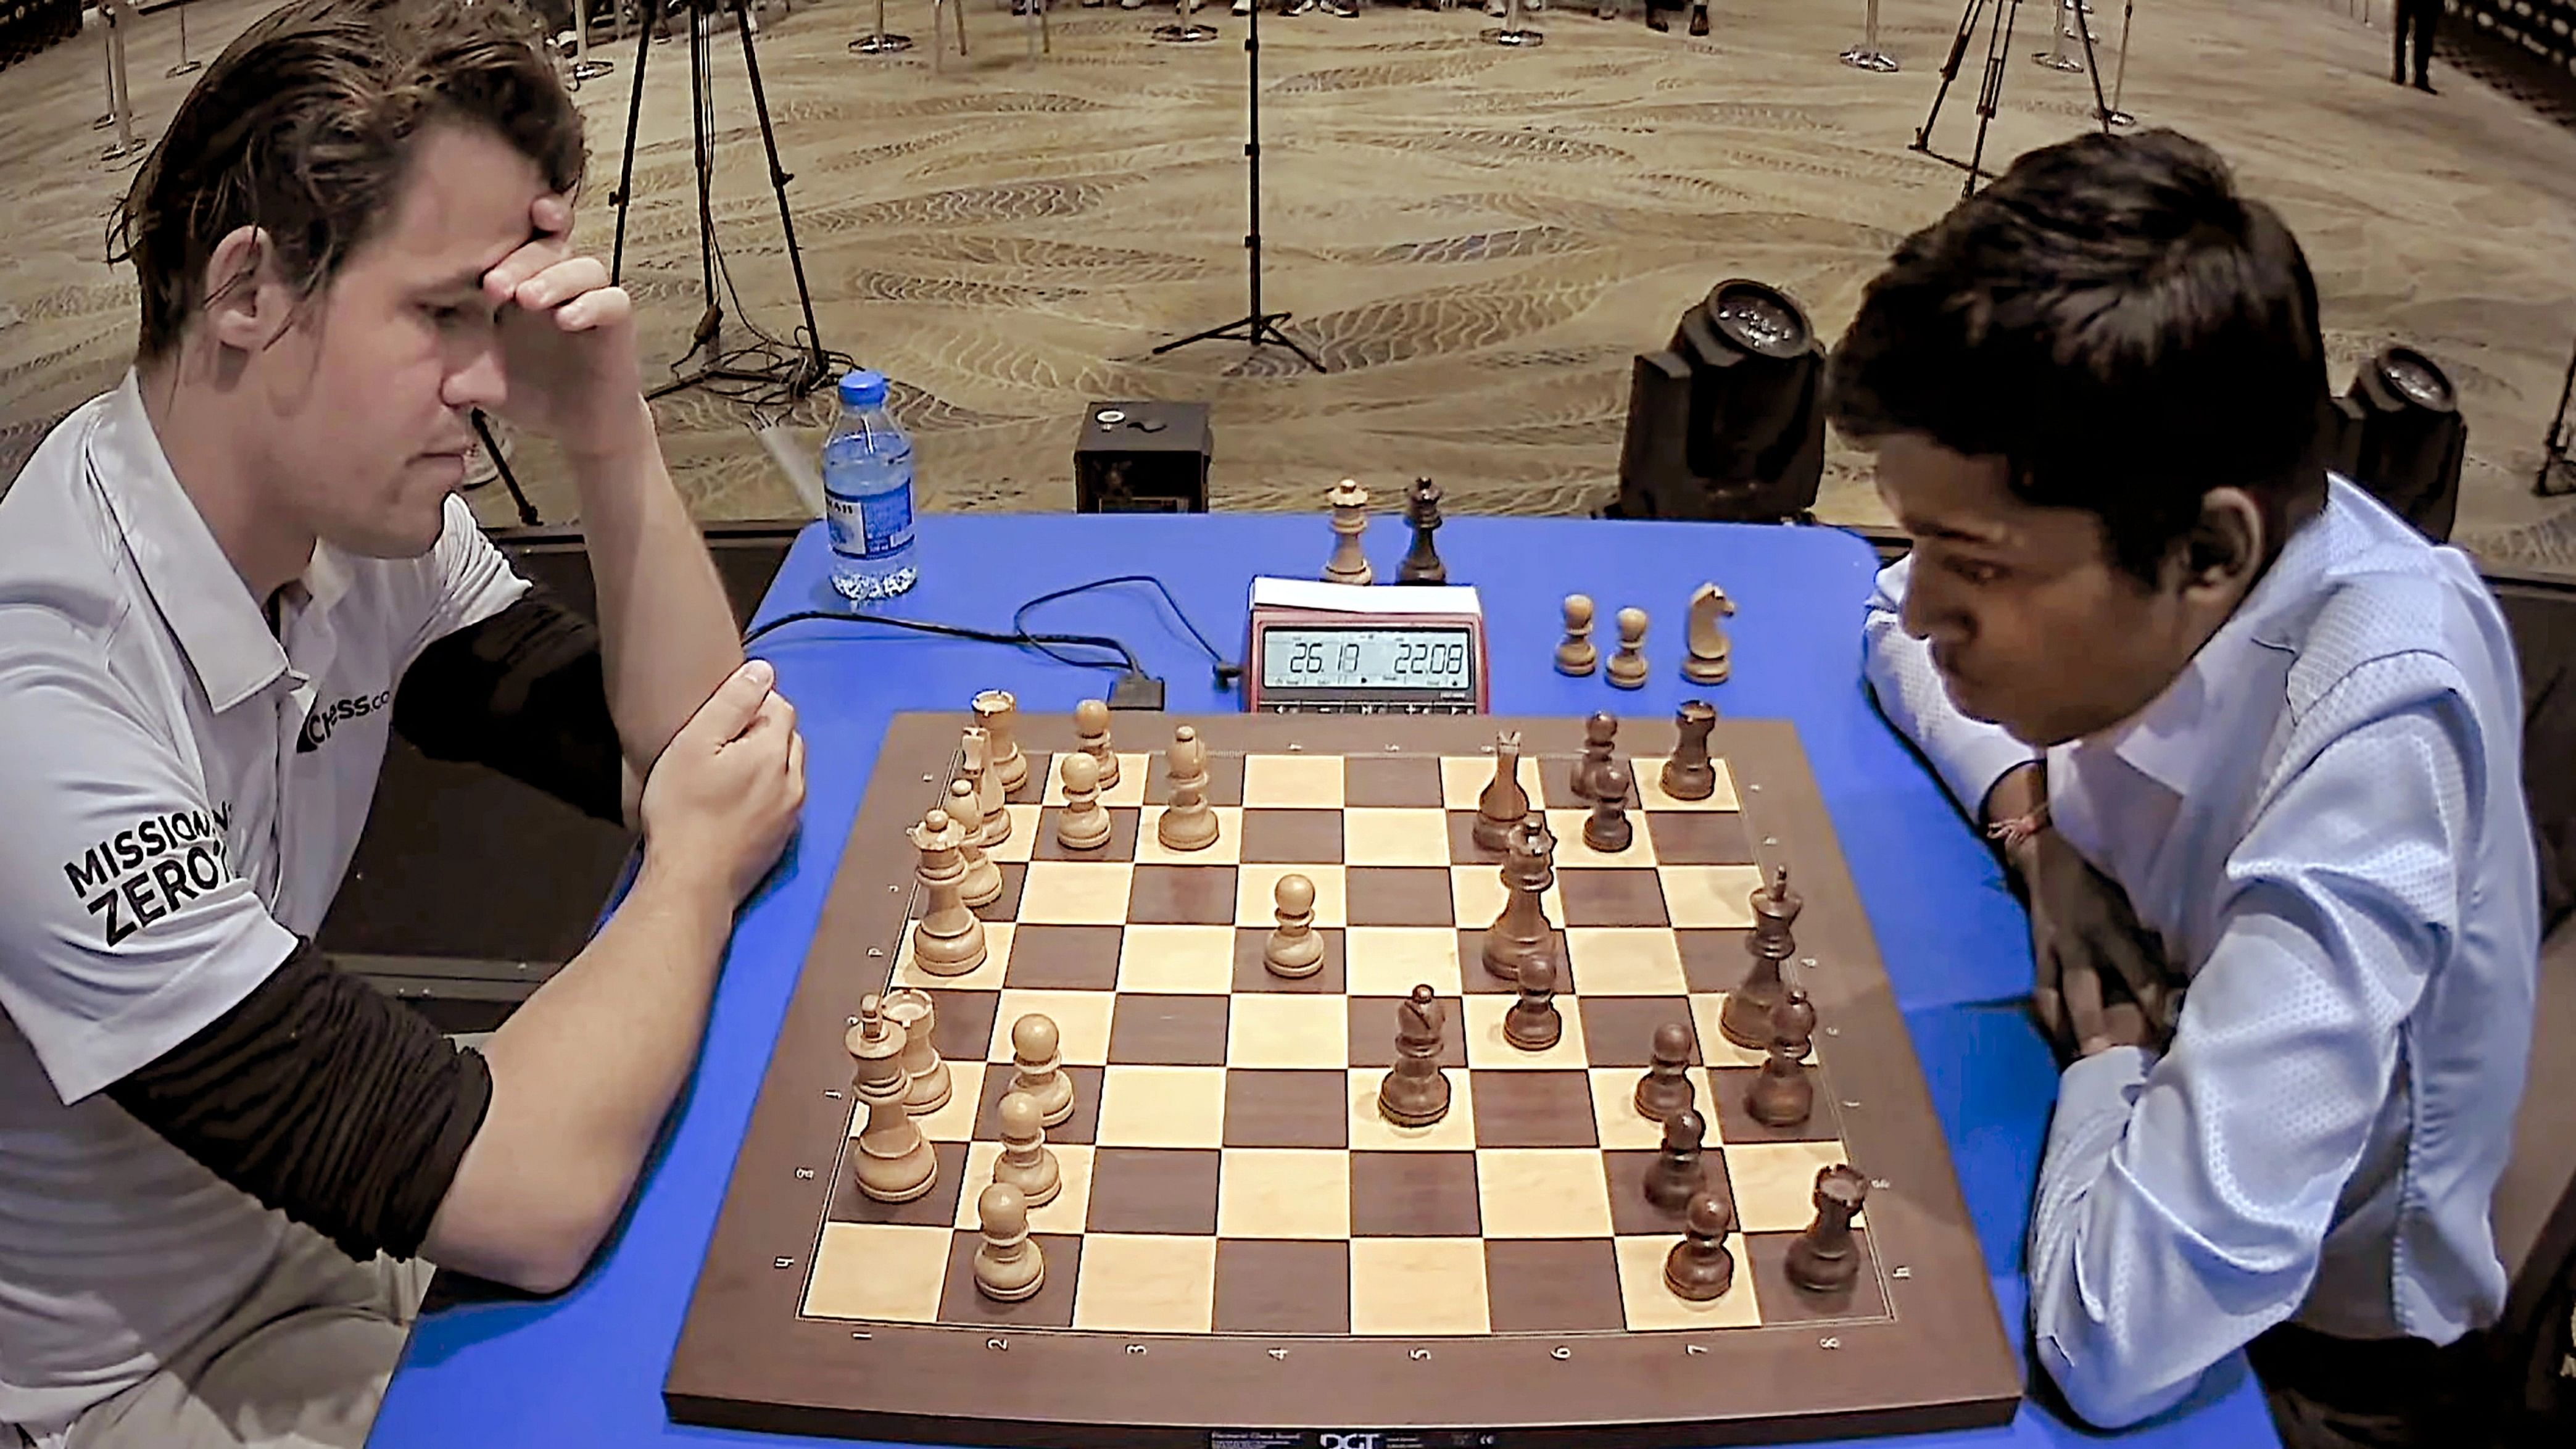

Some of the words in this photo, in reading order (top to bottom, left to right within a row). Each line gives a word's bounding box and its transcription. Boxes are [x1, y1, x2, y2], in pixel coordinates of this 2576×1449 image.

[1394, 643, 1464, 674] 22.08
[64, 810, 211, 899] MISSION
[86, 846, 218, 947] ZERO
[775, 1258, 795, 1268] h
[987, 1339, 1008, 1350] 2
[1820, 1338, 1840, 1348] 8
[1127, 1345, 1147, 1355] 3
[1268, 1349, 1288, 1360] 4
[1410, 1349, 1431, 1360] 5
[1551, 1348, 1571, 1359] 6
[1688, 1345, 1708, 1355] 7
